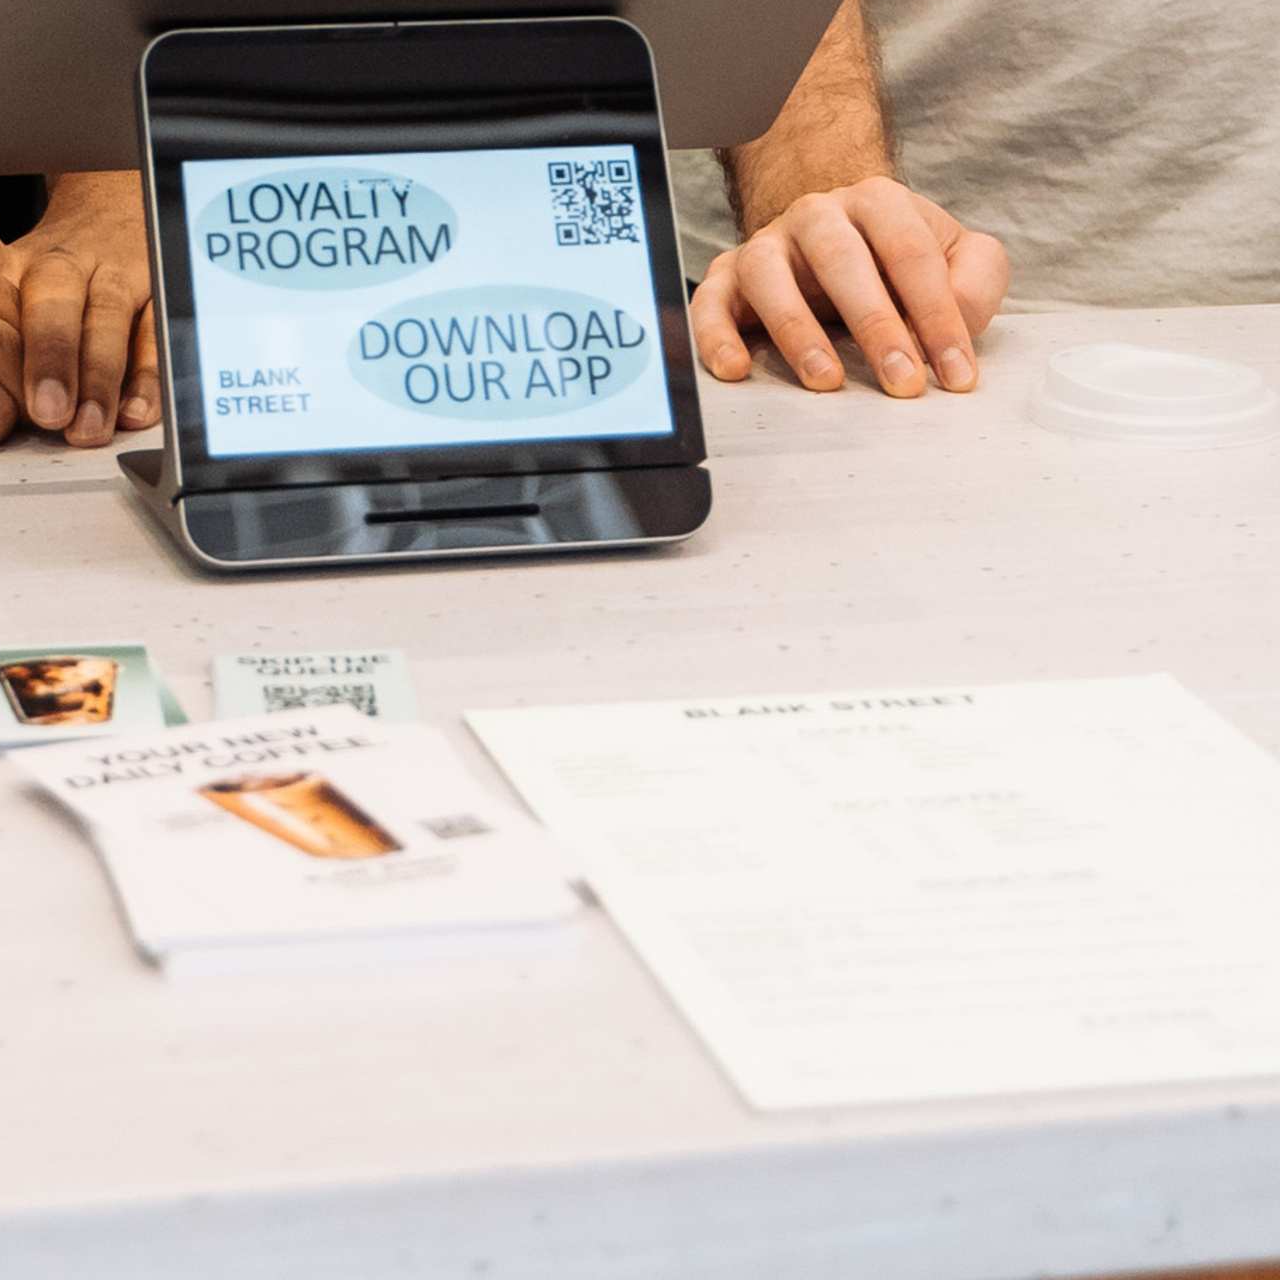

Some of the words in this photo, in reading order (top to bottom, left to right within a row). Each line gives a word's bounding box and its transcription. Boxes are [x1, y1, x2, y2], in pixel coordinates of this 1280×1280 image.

[227, 179, 413, 224] LOYALTY
[206, 224, 451, 271] PROGRAM
[359, 309, 646, 361] DOWNLOAD
[219, 367, 302, 389] BLANK
[404, 360, 511, 405] OUR
[524, 355, 612, 399] APP
[215, 393, 312, 416] STREET
[237, 655, 314, 666] SKIP
[324, 654, 390, 665] THE
[256, 665, 375, 675] QUEUE
[683, 703, 816, 719] BLANK
[829, 694, 974, 711] STREET
[64, 762, 184, 788] DAILY
[203, 734, 375, 768] COFFEE
[88, 741, 211, 765] YOUR
[222, 724, 319, 747] NEW
